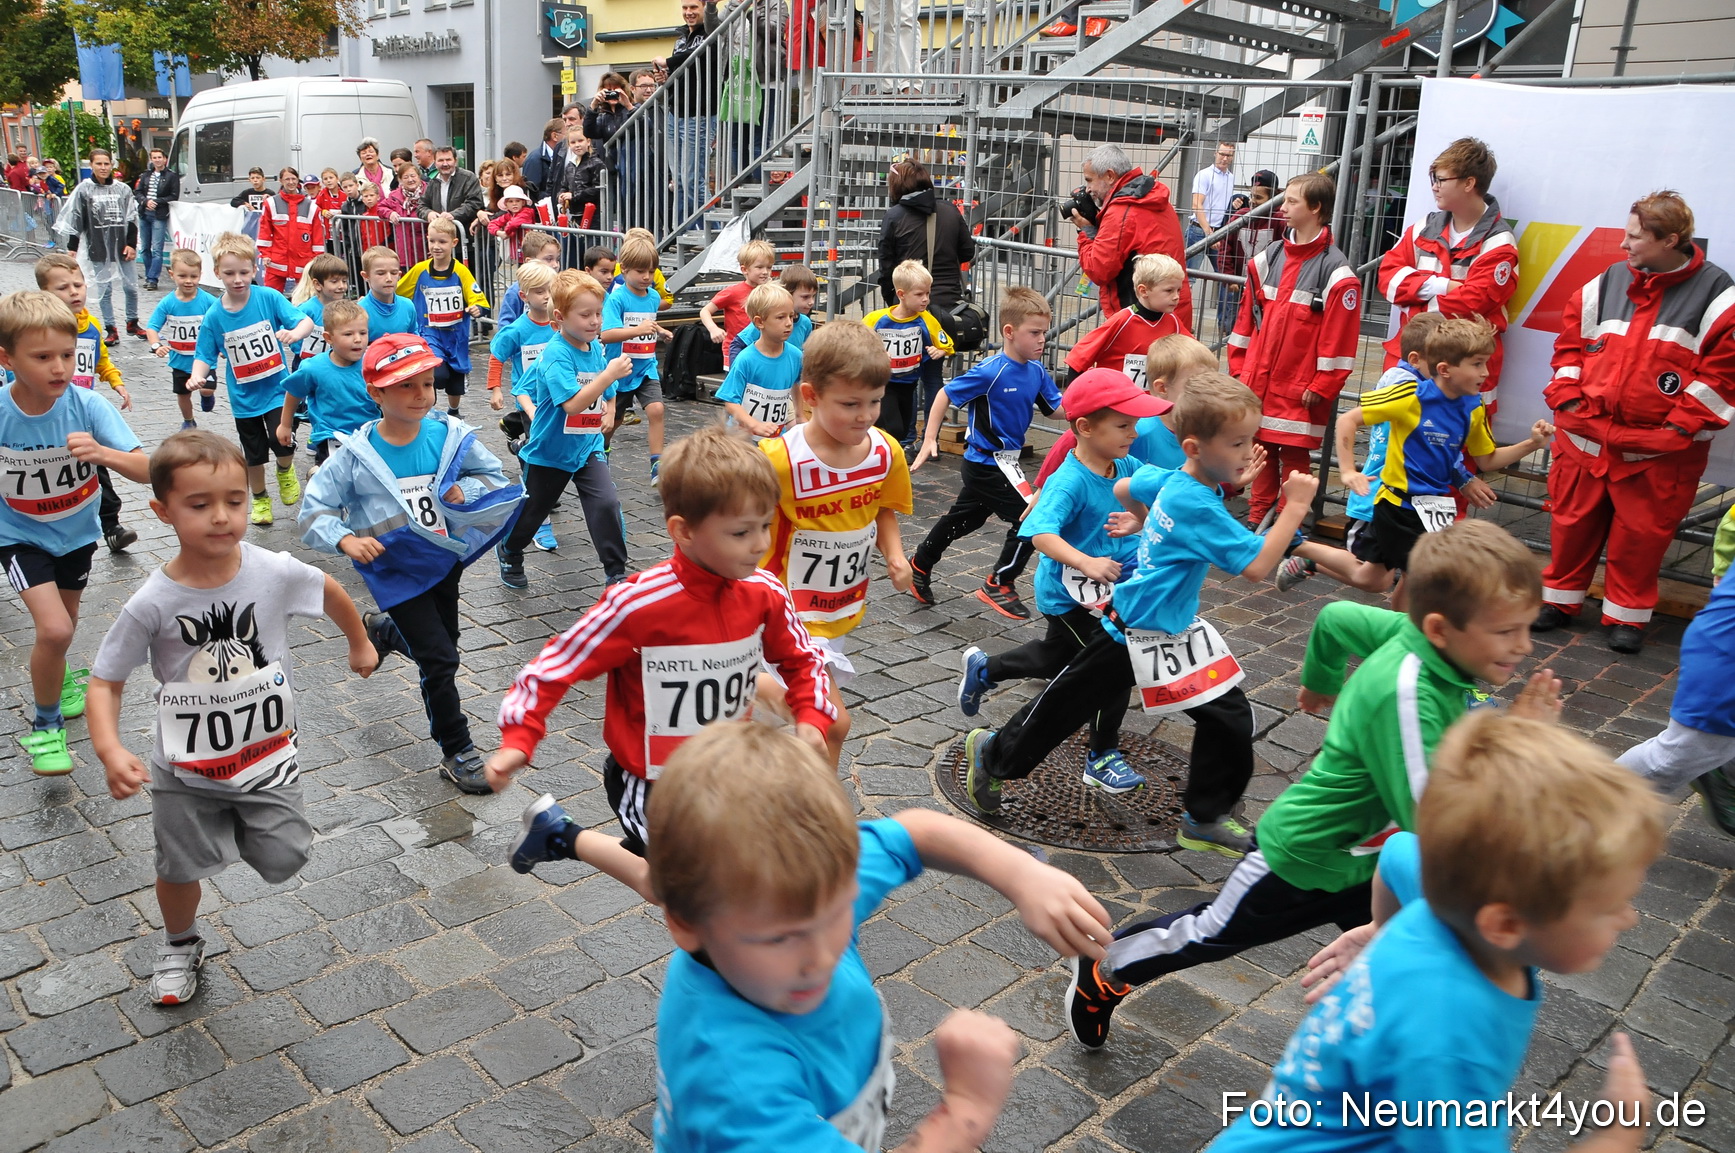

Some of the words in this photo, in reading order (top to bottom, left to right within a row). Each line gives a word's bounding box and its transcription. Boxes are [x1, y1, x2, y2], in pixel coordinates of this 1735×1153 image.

[560, 18, 577, 39] G2
[428, 296, 460, 312] 7116
[228, 334, 275, 364] 7150
[883, 338, 920, 356] 7187
[77, 352, 93, 373] 94
[745, 388, 765, 400] PARTL
[749, 398, 788, 423] 7159
[0, 454, 32, 467] PARTL
[6, 460, 92, 496] 7146
[37, 495, 79, 513] Niklas
[795, 499, 844, 520] MAX
[794, 537, 831, 550] PARTL
[832, 534, 870, 551] Neumarkt
[801, 545, 871, 588] 7134
[809, 591, 856, 610] Andreas
[646, 660, 699, 673] PARTL
[702, 647, 759, 672] Neumarkt
[1141, 625, 1215, 682] 7577
[162, 695, 207, 706] PARTL
[210, 680, 272, 705] Neumarkt
[660, 661, 759, 728] 7095
[1155, 683, 1197, 703] Elias
[175, 694, 284, 754] 7070
